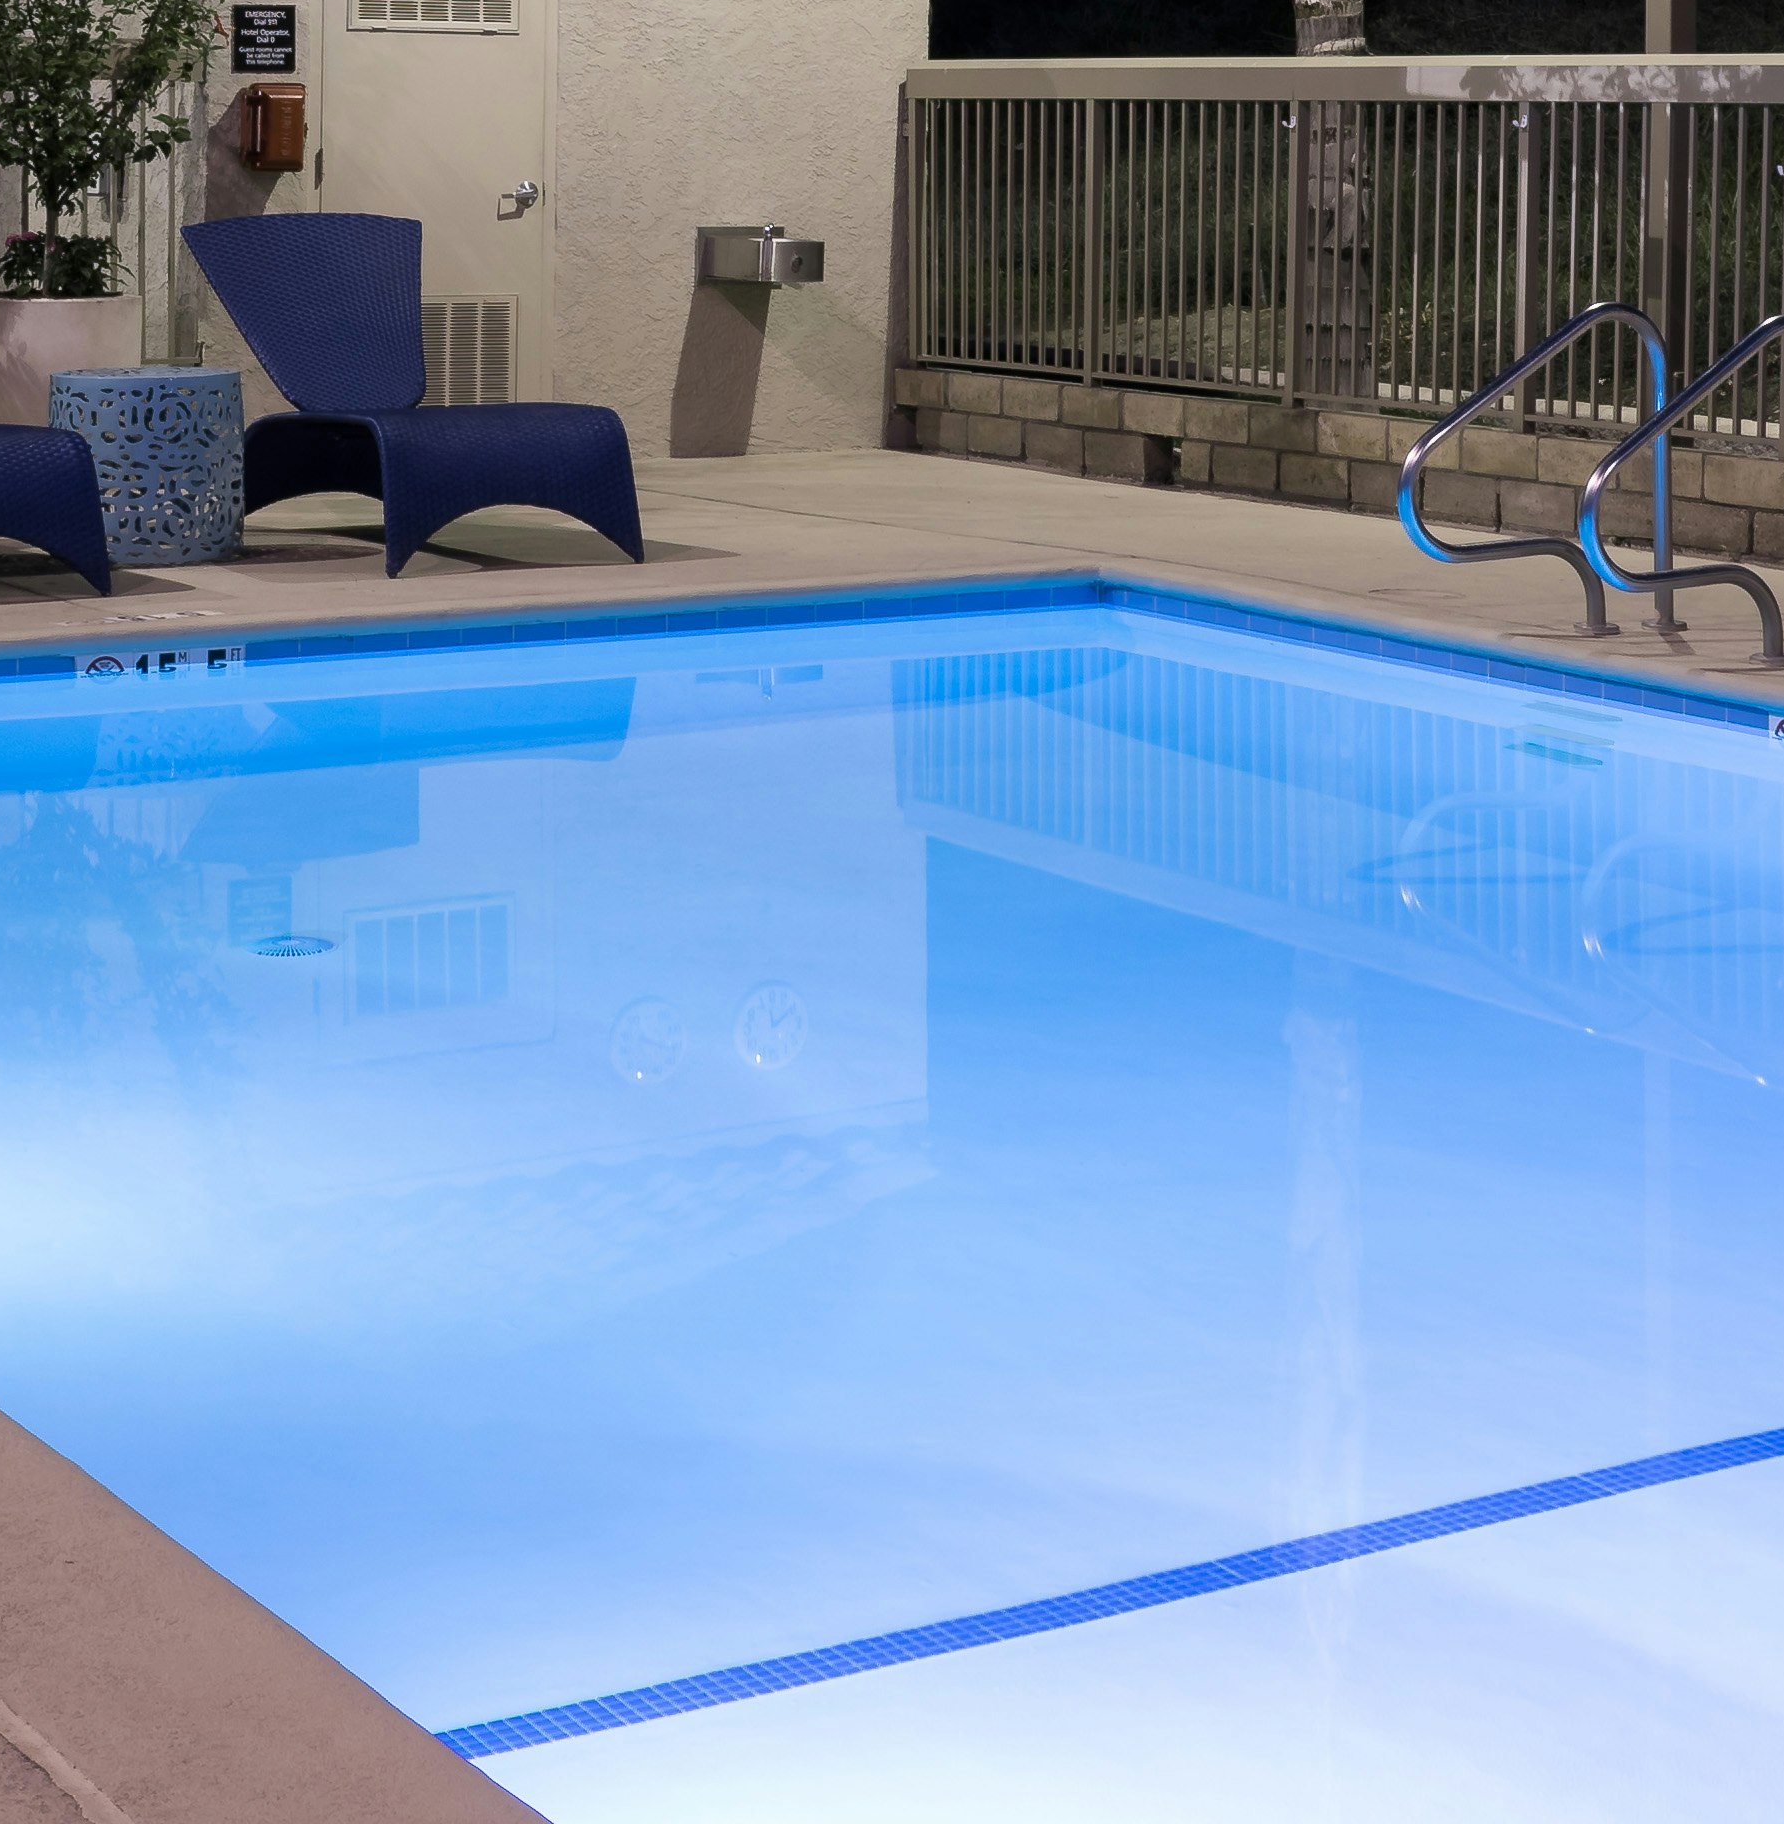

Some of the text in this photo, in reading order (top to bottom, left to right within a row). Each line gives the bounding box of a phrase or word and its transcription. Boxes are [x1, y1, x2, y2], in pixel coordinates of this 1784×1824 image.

[179, 652, 187, 663] M
[207, 649, 227, 670] 5
[231, 648, 241, 661] FT
